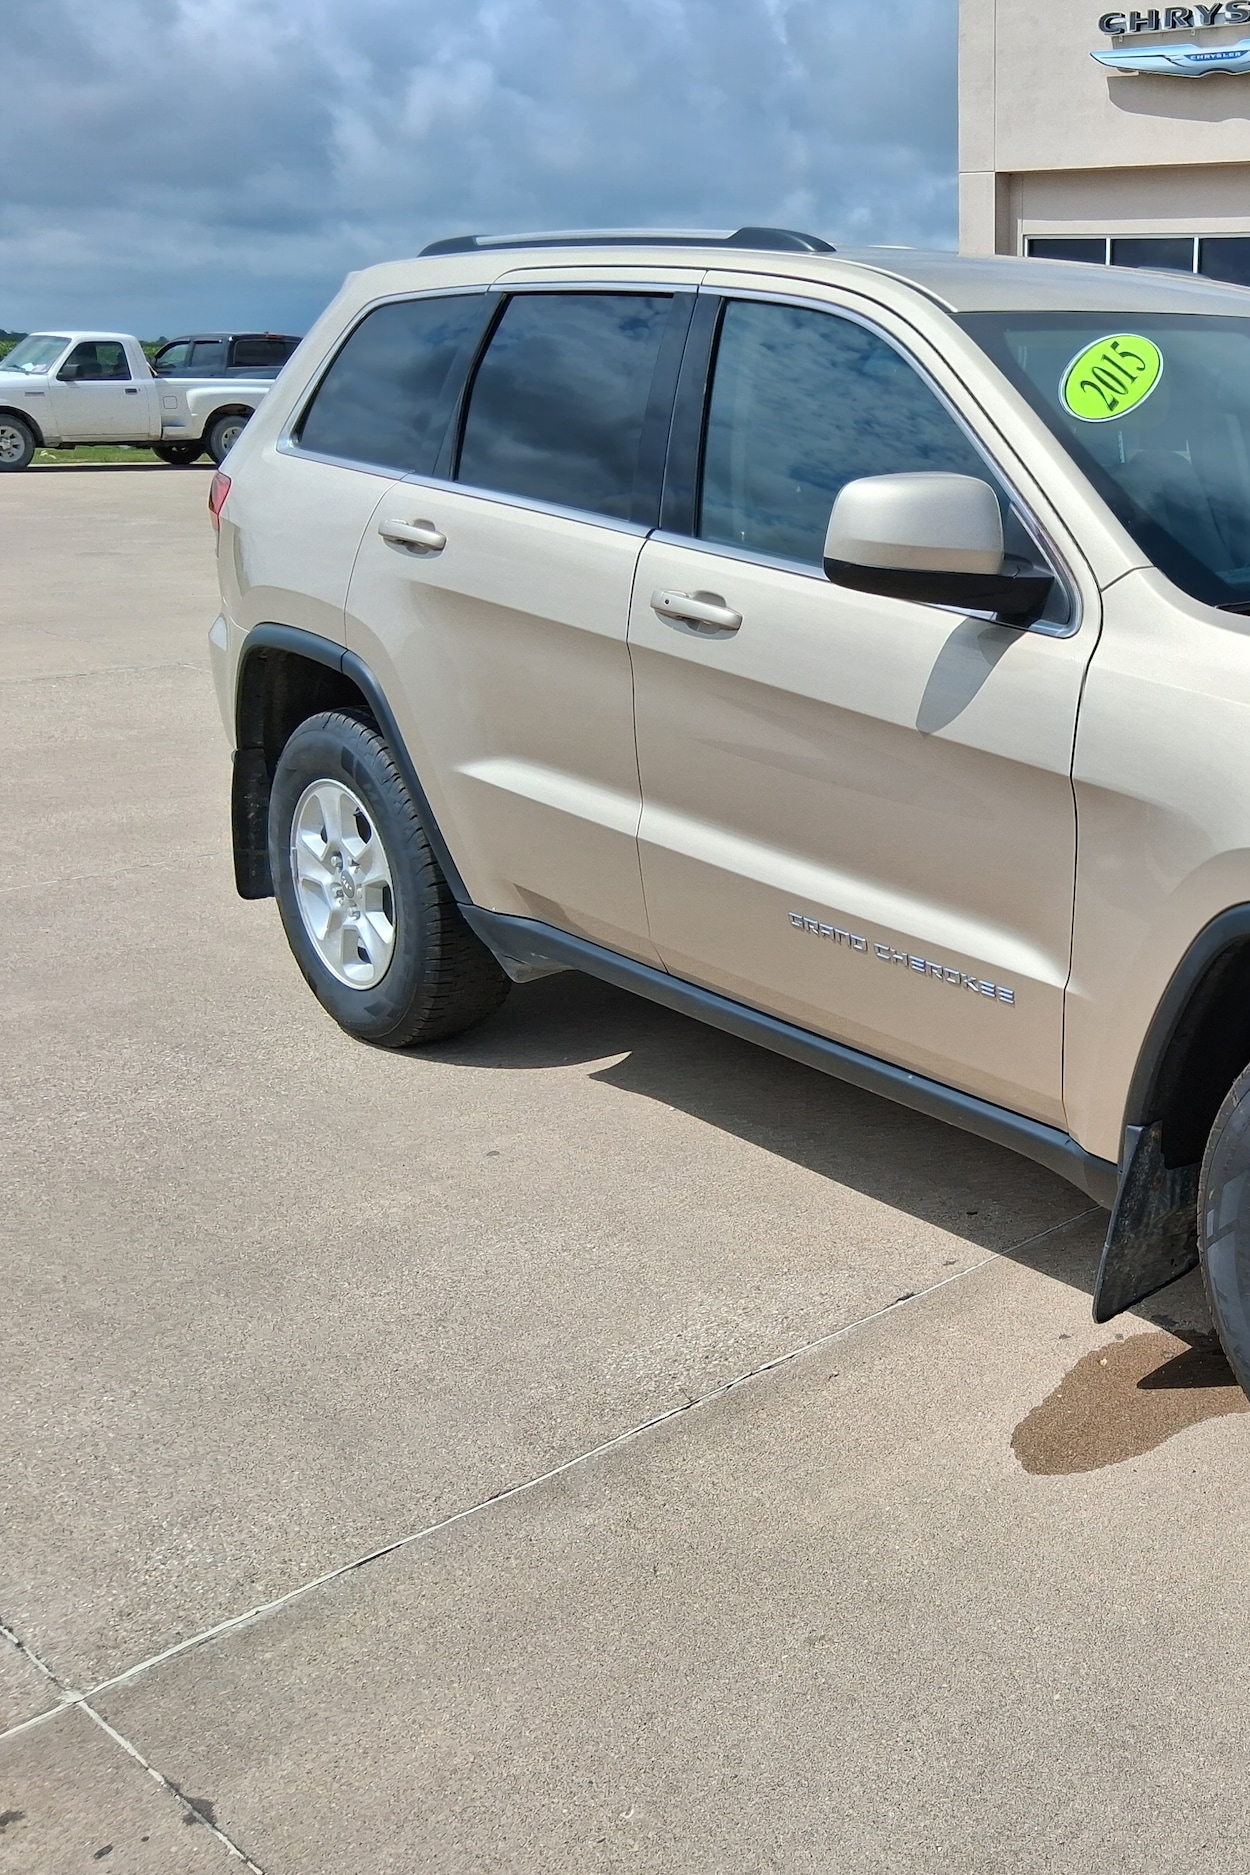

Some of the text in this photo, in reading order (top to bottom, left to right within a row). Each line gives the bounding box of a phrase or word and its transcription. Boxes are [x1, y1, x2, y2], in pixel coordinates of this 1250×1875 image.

[1190, 51, 1241, 60] CHRYSLER
[1079, 340, 1146, 412] 2015
[788, 911, 1015, 1006] GRAND CHEROKEE
